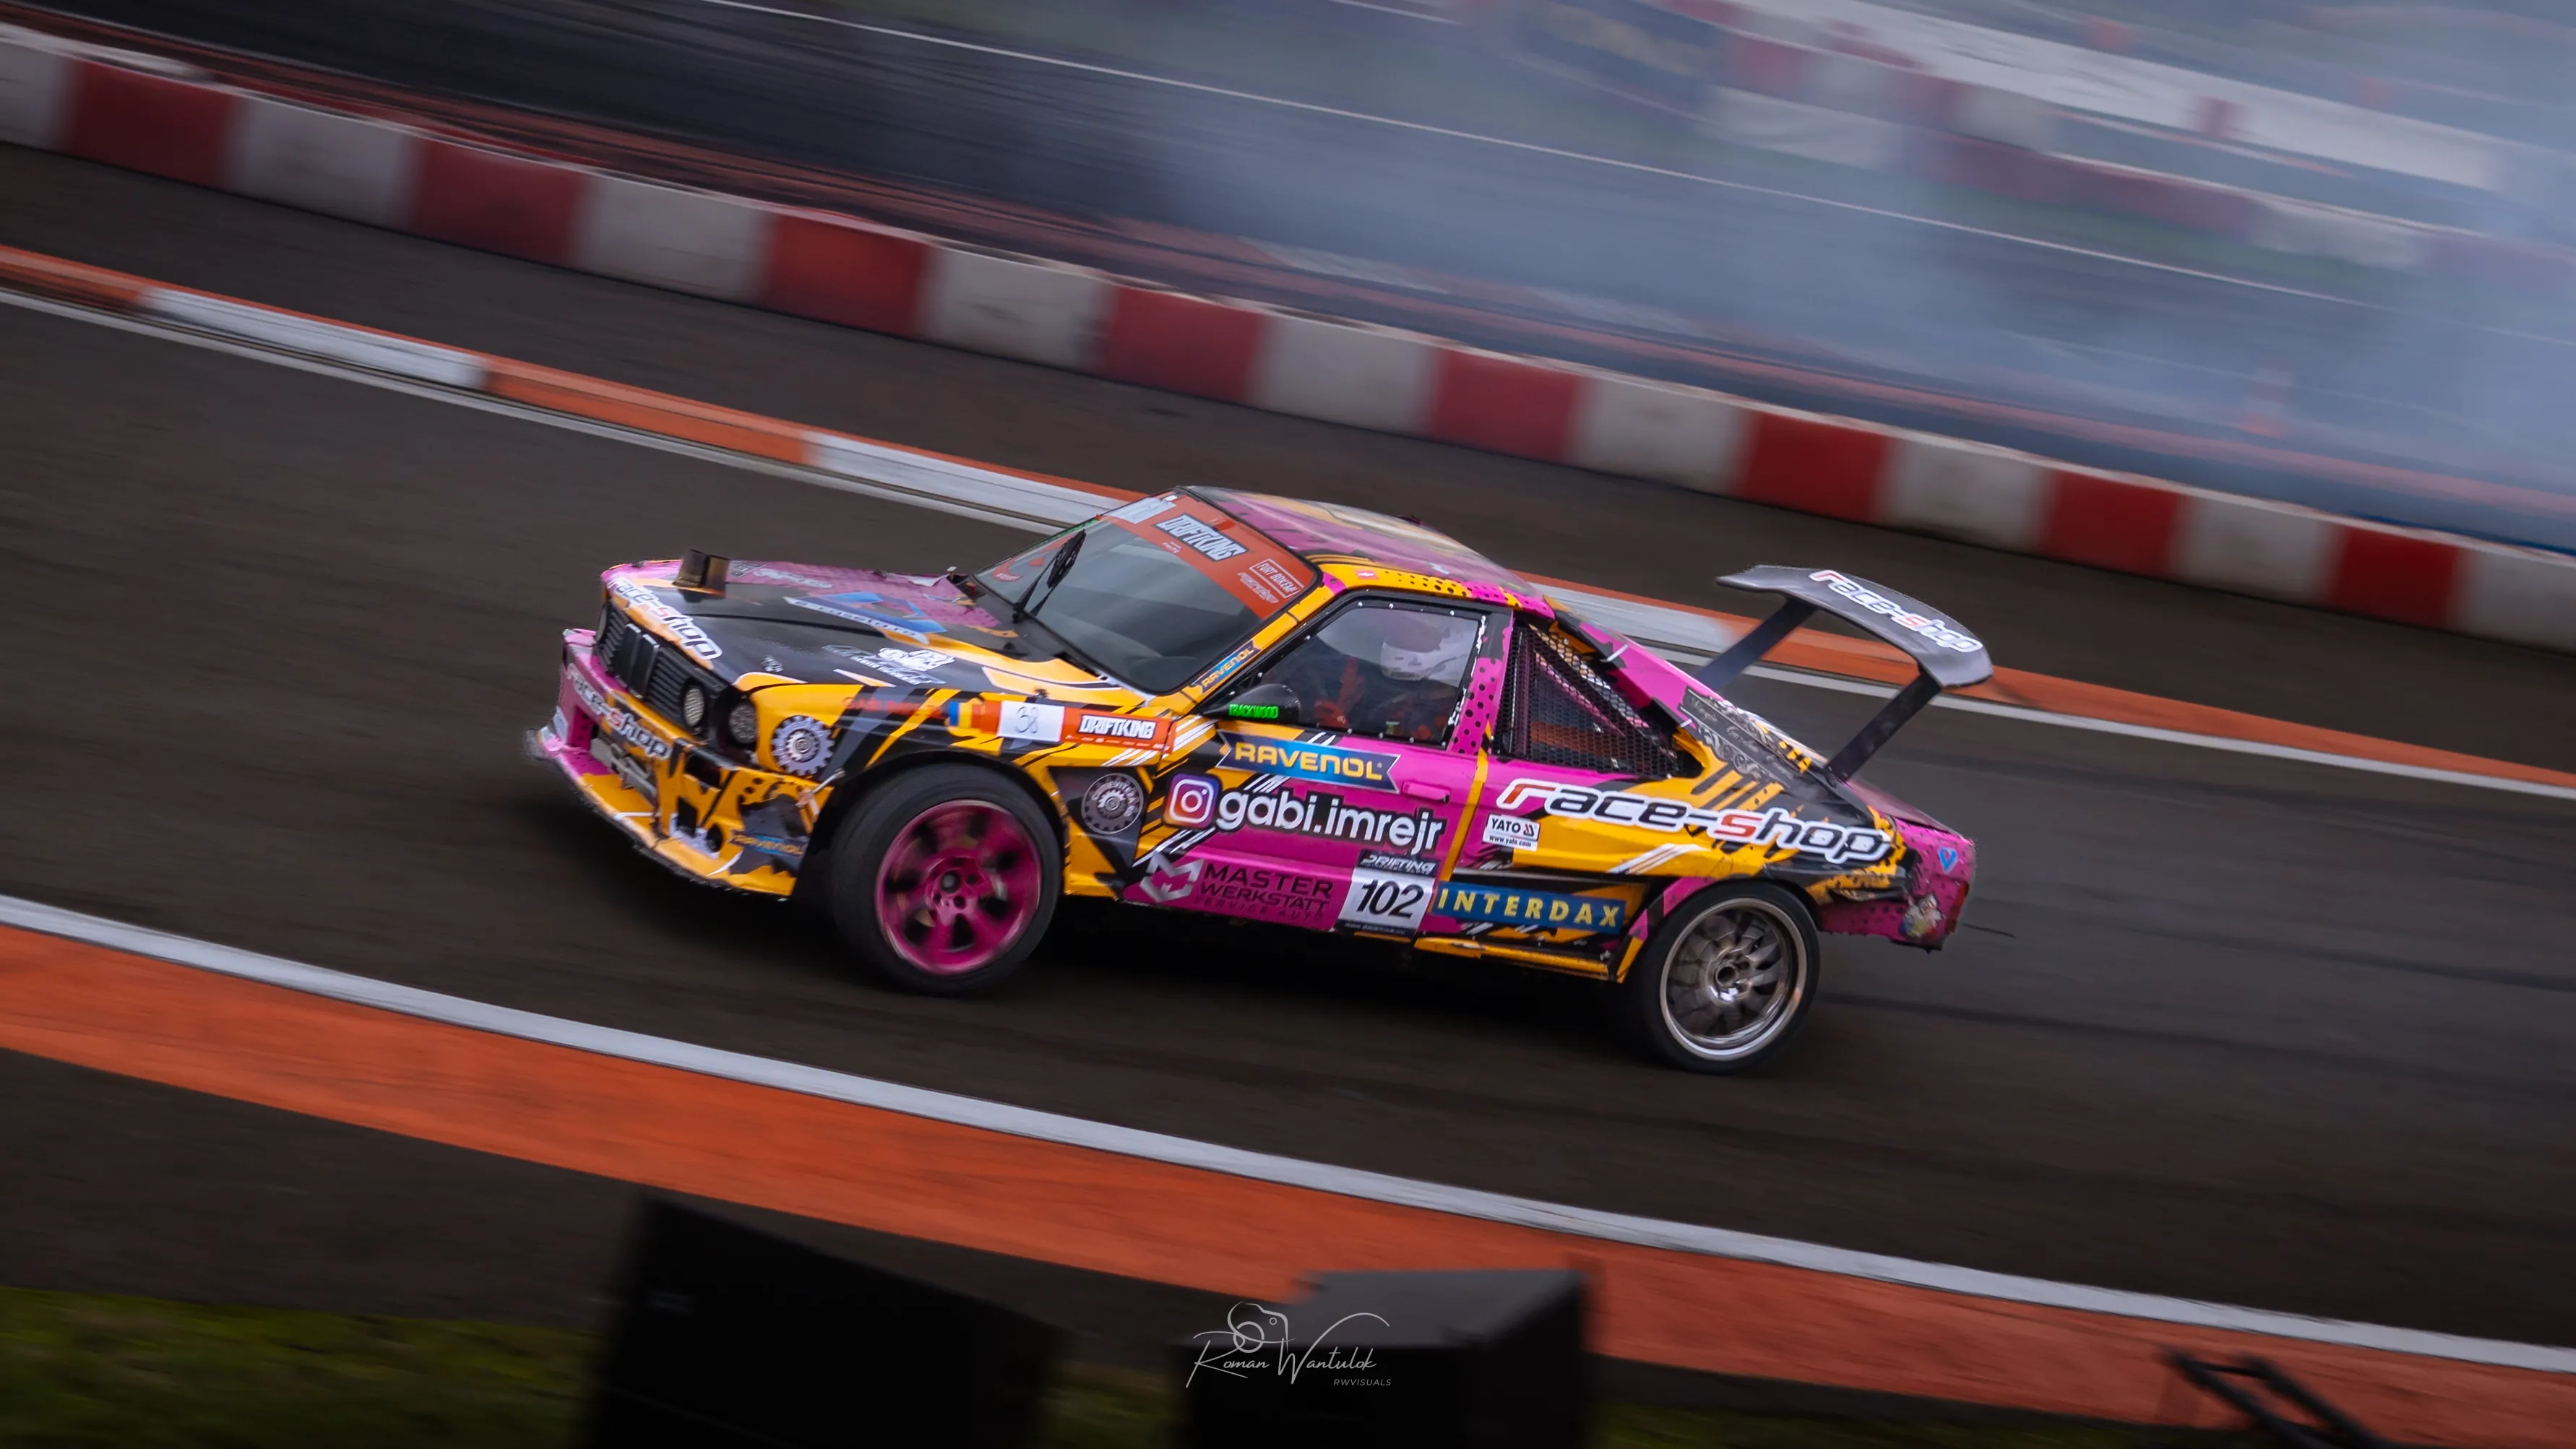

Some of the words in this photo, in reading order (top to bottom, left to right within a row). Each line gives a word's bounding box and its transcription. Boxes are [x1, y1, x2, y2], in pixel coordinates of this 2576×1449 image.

[1809, 570, 1983, 652] race-shop
[1202, 649, 1254, 688] RAVENOL
[1235, 742, 1382, 781] RAVENOL
[1216, 790, 1443, 855] gabi.imrejr
[1489, 835, 1531, 847] www.yato.com
[1491, 818, 1521, 833] YATO
[1496, 780, 1887, 863] race-shop
[1204, 863, 1333, 899] MASTER
[1361, 855, 1436, 875] DRIFTING
[1194, 896, 1270, 914] SERVICE
[1278, 907, 1324, 922] AUTO
[1200, 882, 1331, 912] WERKSTATT
[1356, 879, 1424, 919] 102
[1437, 888, 1619, 927] INTERDAX
